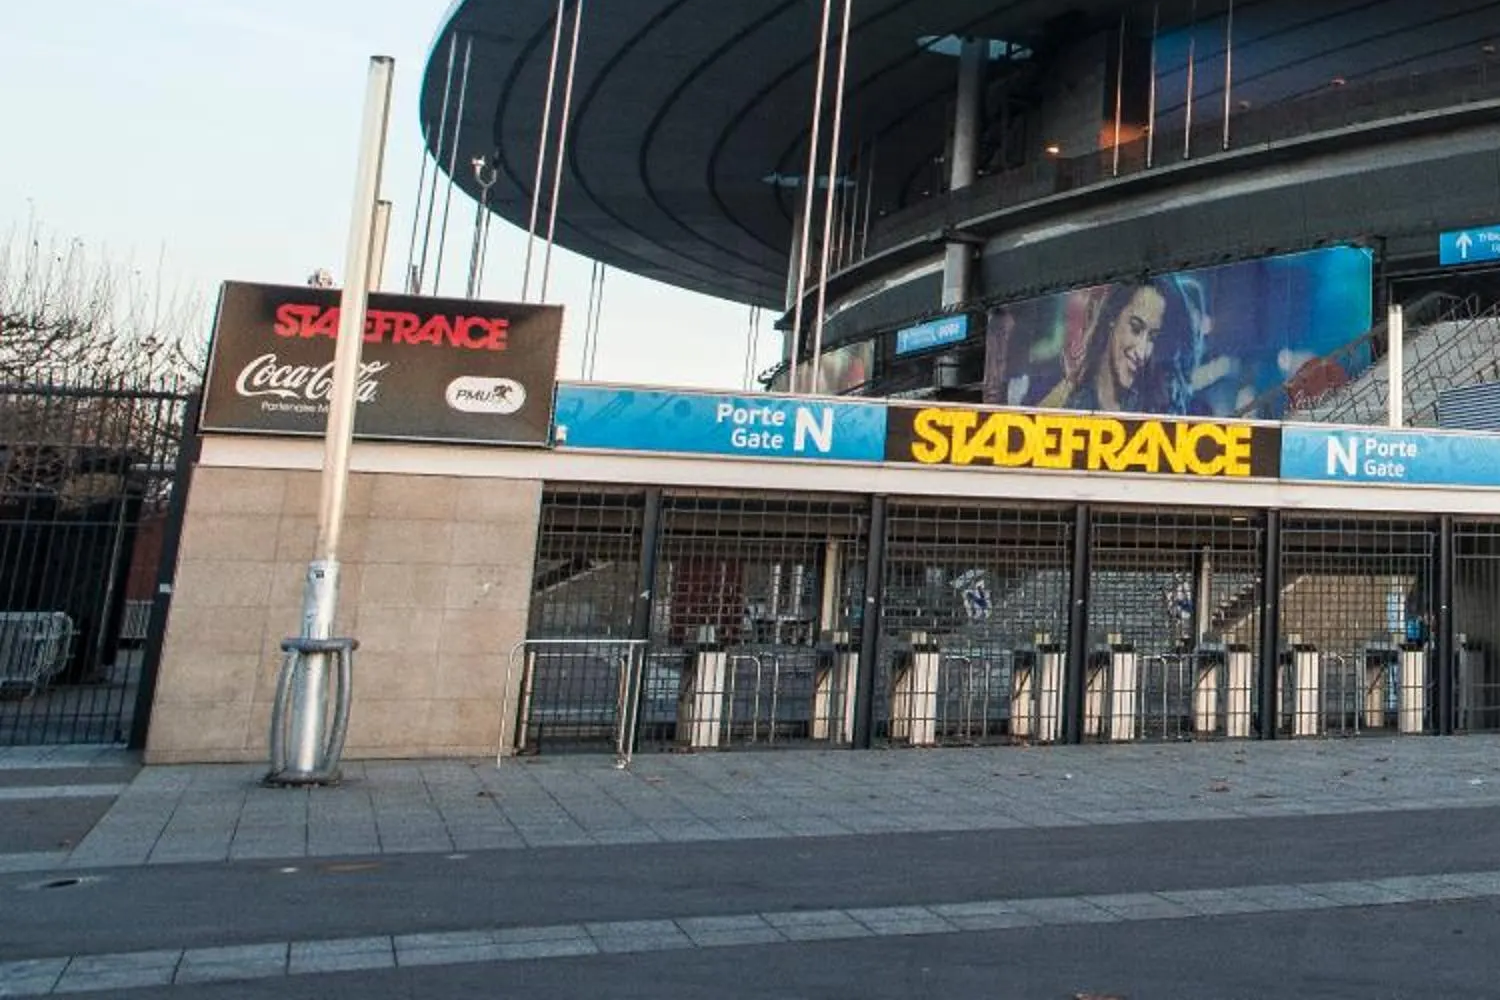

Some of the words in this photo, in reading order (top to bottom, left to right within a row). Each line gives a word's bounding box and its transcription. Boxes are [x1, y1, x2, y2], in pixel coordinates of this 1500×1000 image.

[273, 303, 509, 351] STAEFRANCE
[456, 389, 491, 402] PMU
[716, 403, 786, 426] Porte
[731, 428, 784, 449] Gate
[793, 407, 834, 452] N
[911, 407, 1252, 476] STADEFRANCE
[1365, 438, 1418, 457] Porte
[1327, 435, 1357, 476] N
[1363, 459, 1405, 478] Gate
